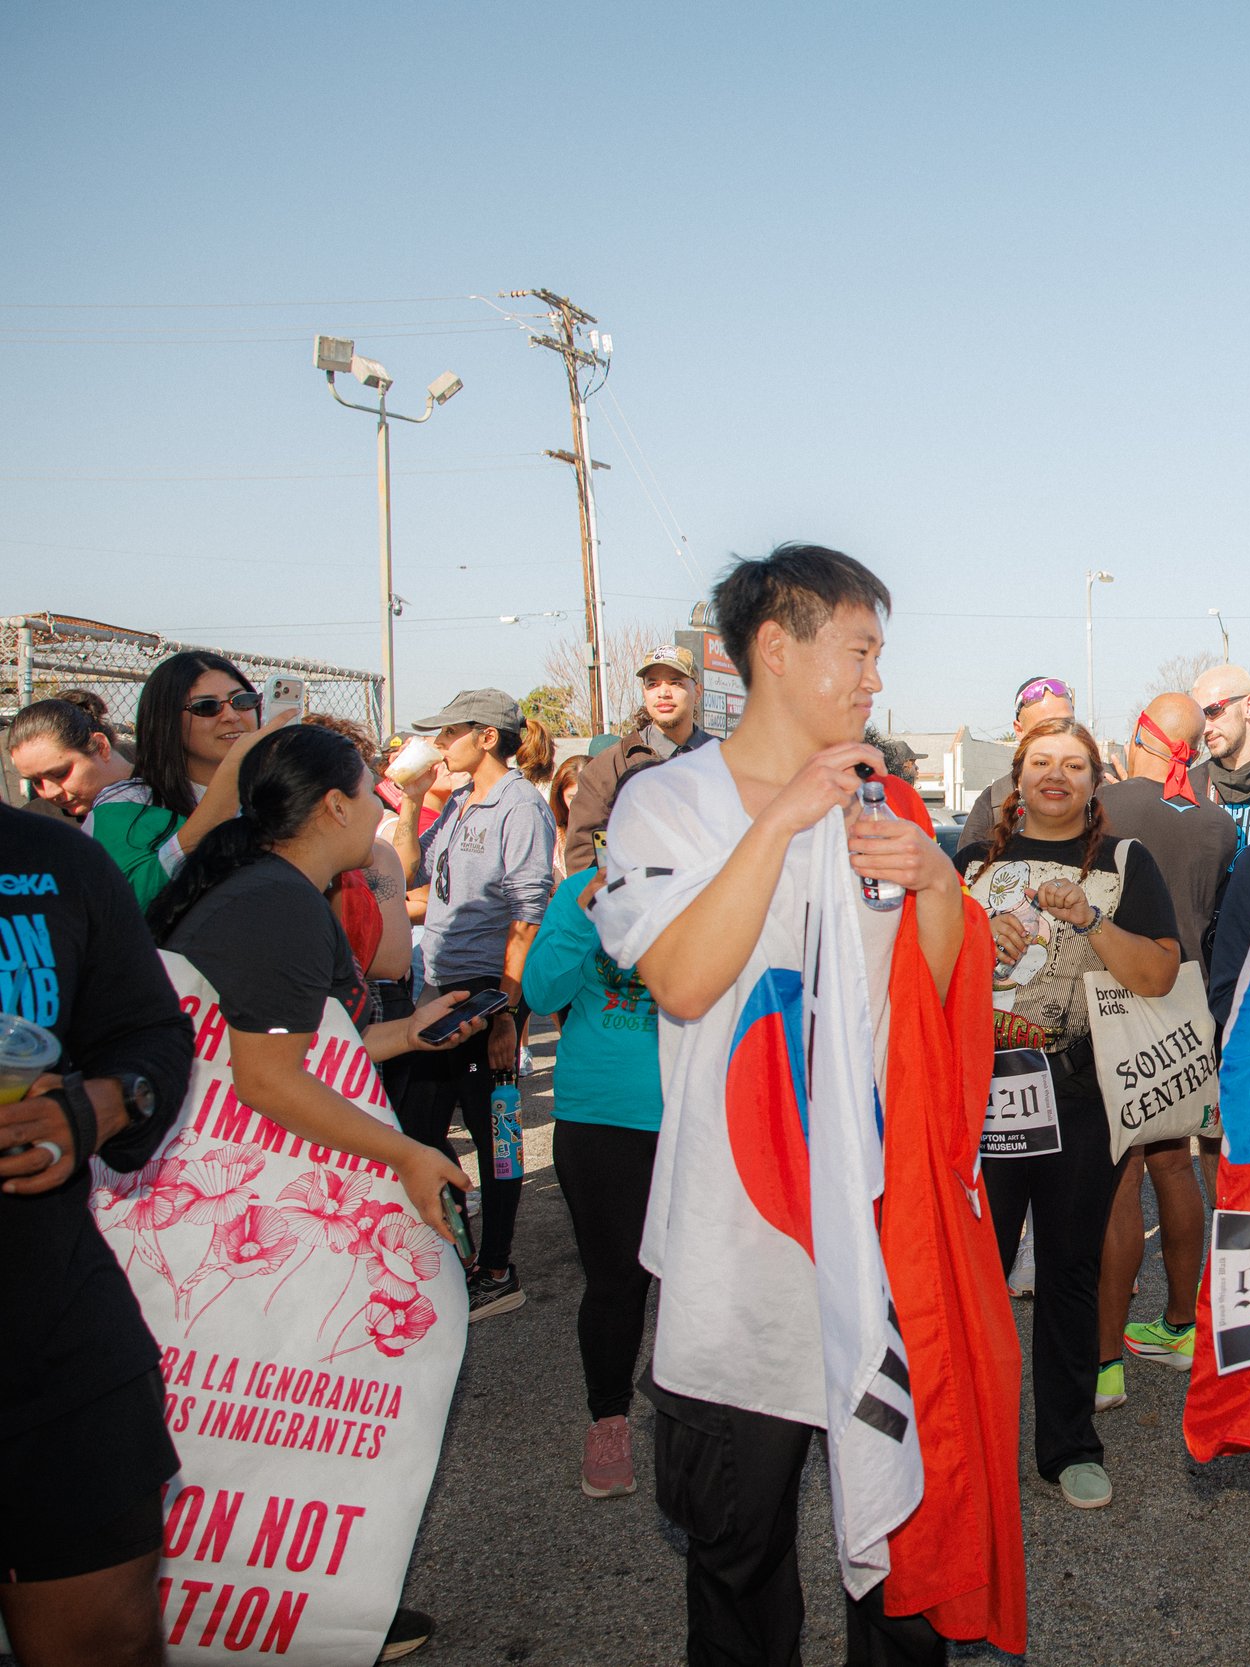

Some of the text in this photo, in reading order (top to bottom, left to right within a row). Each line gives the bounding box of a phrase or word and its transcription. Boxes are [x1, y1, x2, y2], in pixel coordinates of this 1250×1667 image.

[1047, 927, 1065, 978] MEXICO
[1099, 1002, 1130, 1017] kids.
[1115, 1020, 1203, 1091] SOUTH
[986, 1142, 1027, 1151] MUSEUM
[158, 1345, 402, 1420] RA LA IGNORANCIA
[197, 1400, 387, 1460] INMIGRANTES
[160, 1484, 367, 1577] ON NOT
